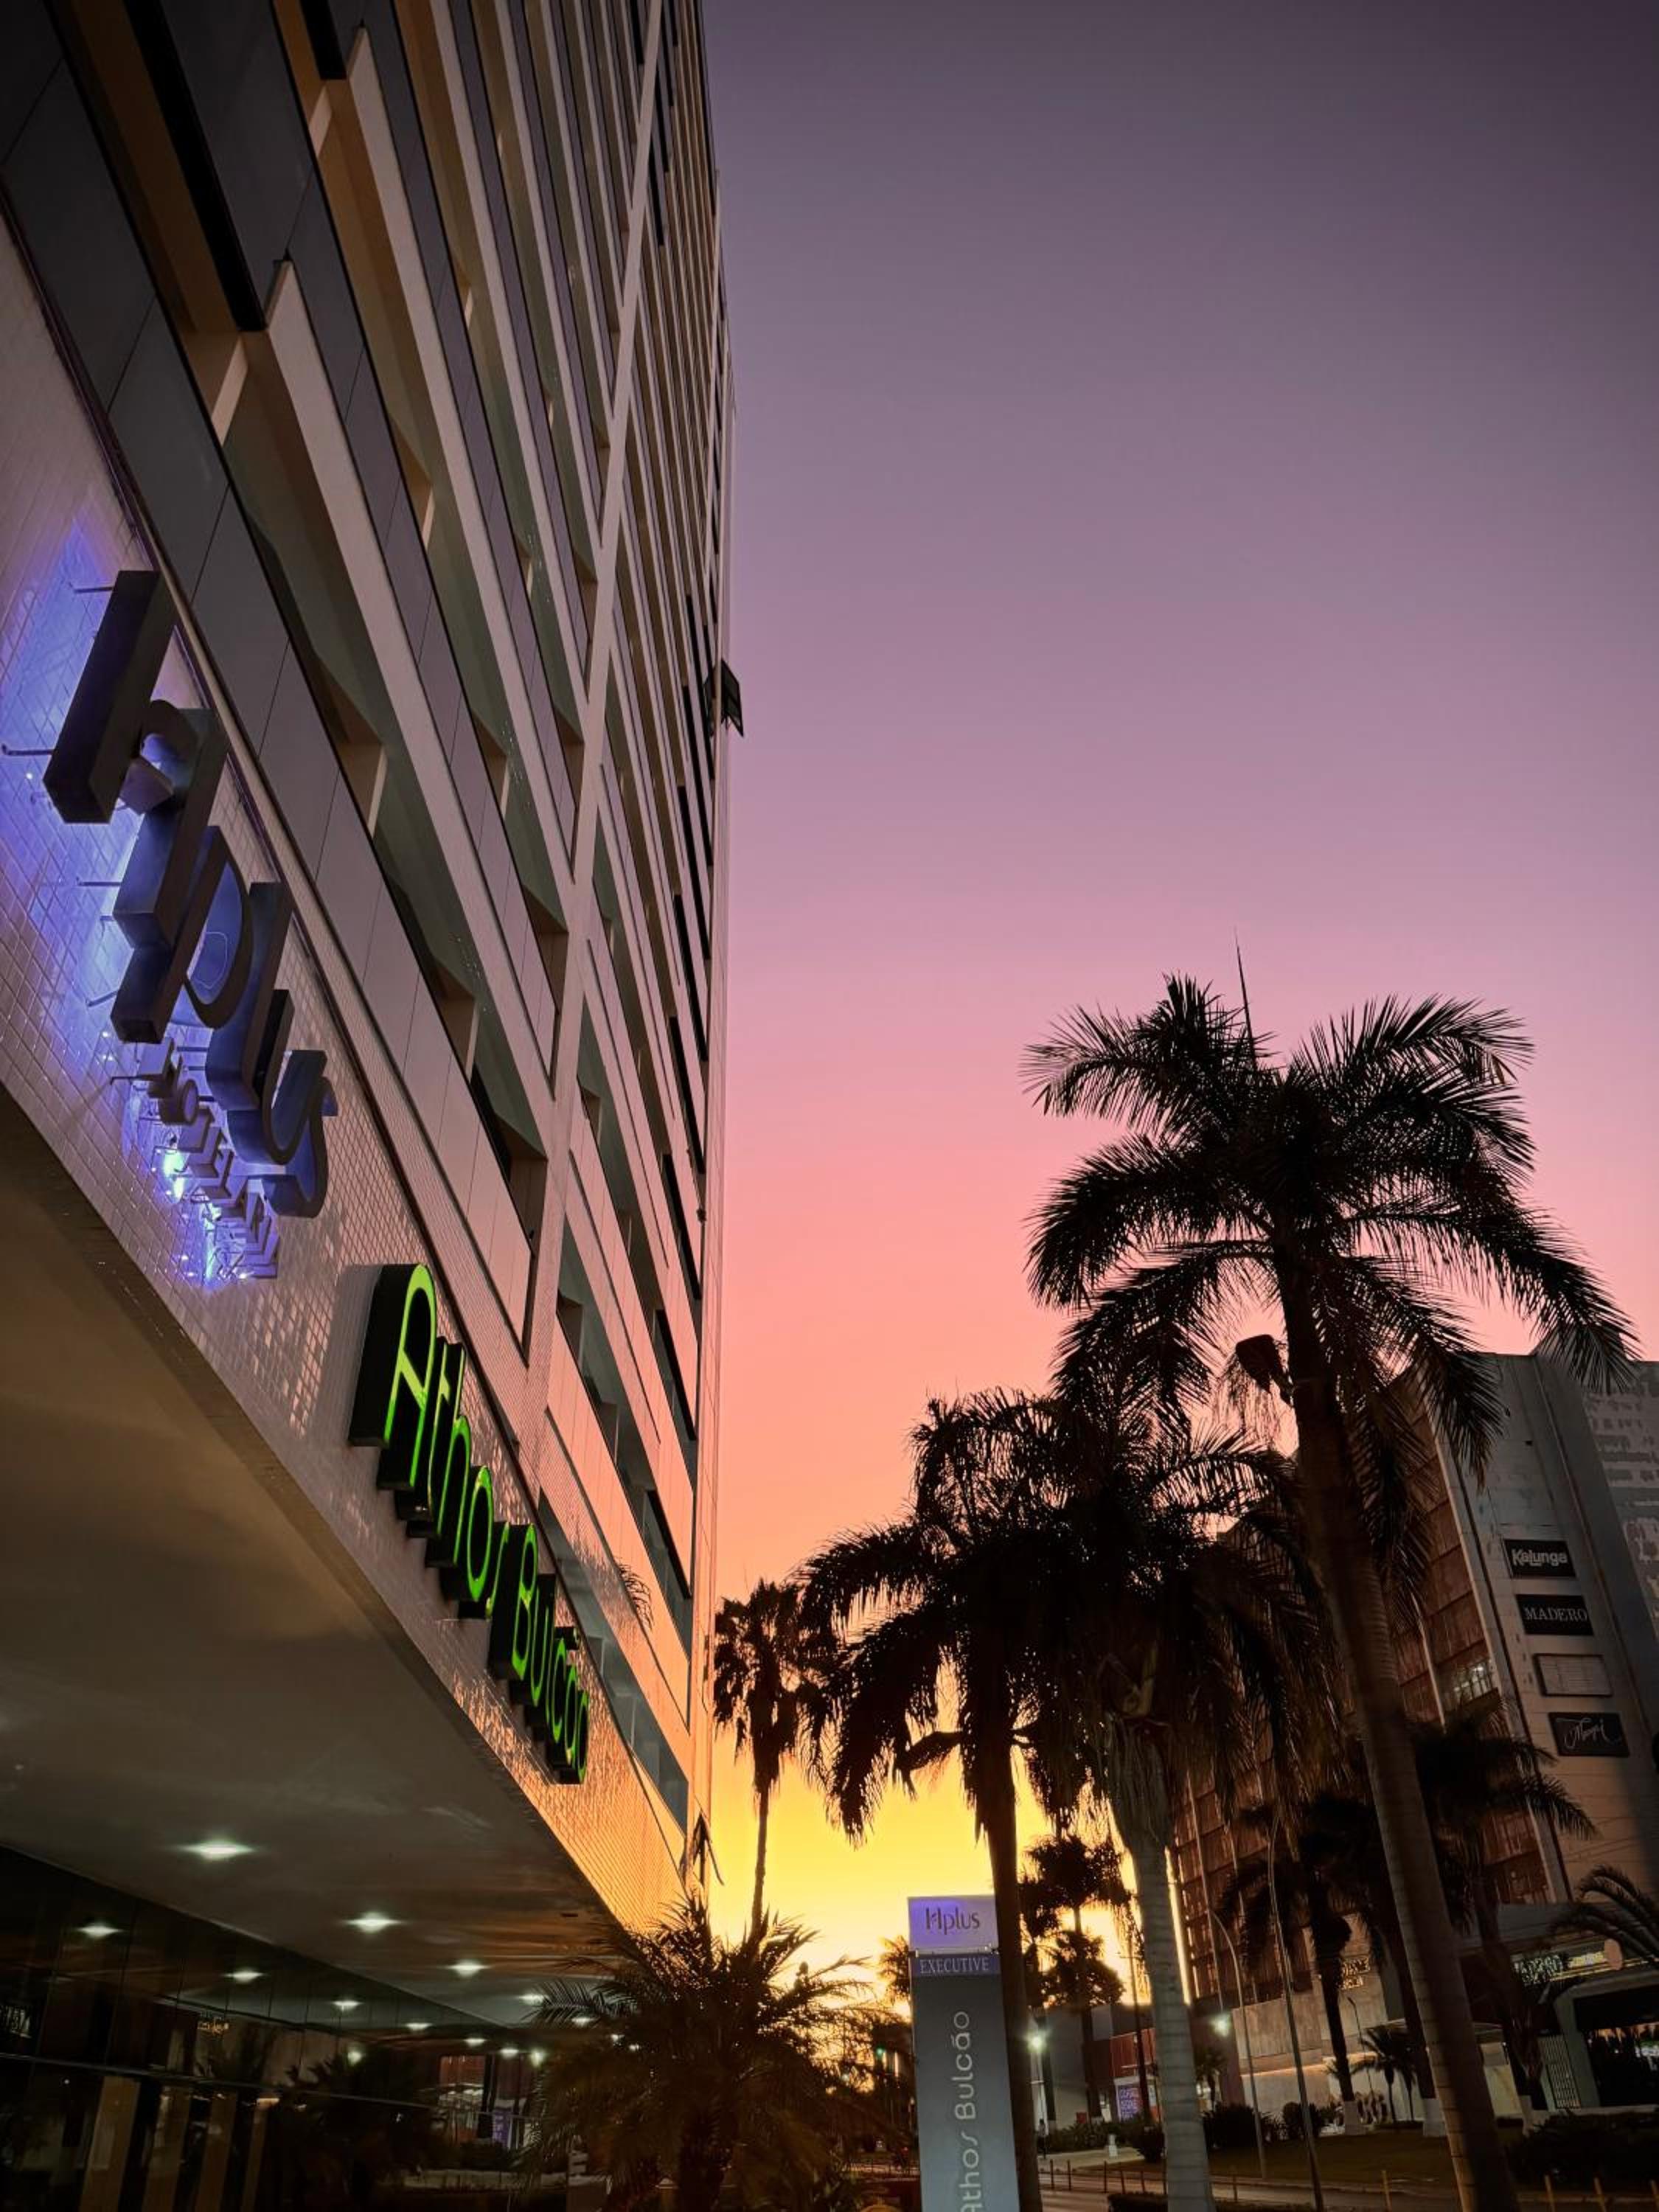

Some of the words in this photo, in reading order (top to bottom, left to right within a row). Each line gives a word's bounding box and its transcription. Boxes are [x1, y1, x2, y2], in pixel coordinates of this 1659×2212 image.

[349, 1262, 510, 1620] Athos
[1523, 1606, 1587, 1623] MADERO
[925, 1906, 980, 1935] Hplus
[919, 1956, 989, 1974] EXECUTIVE
[950, 2011, 976, 2120] Bulcão
